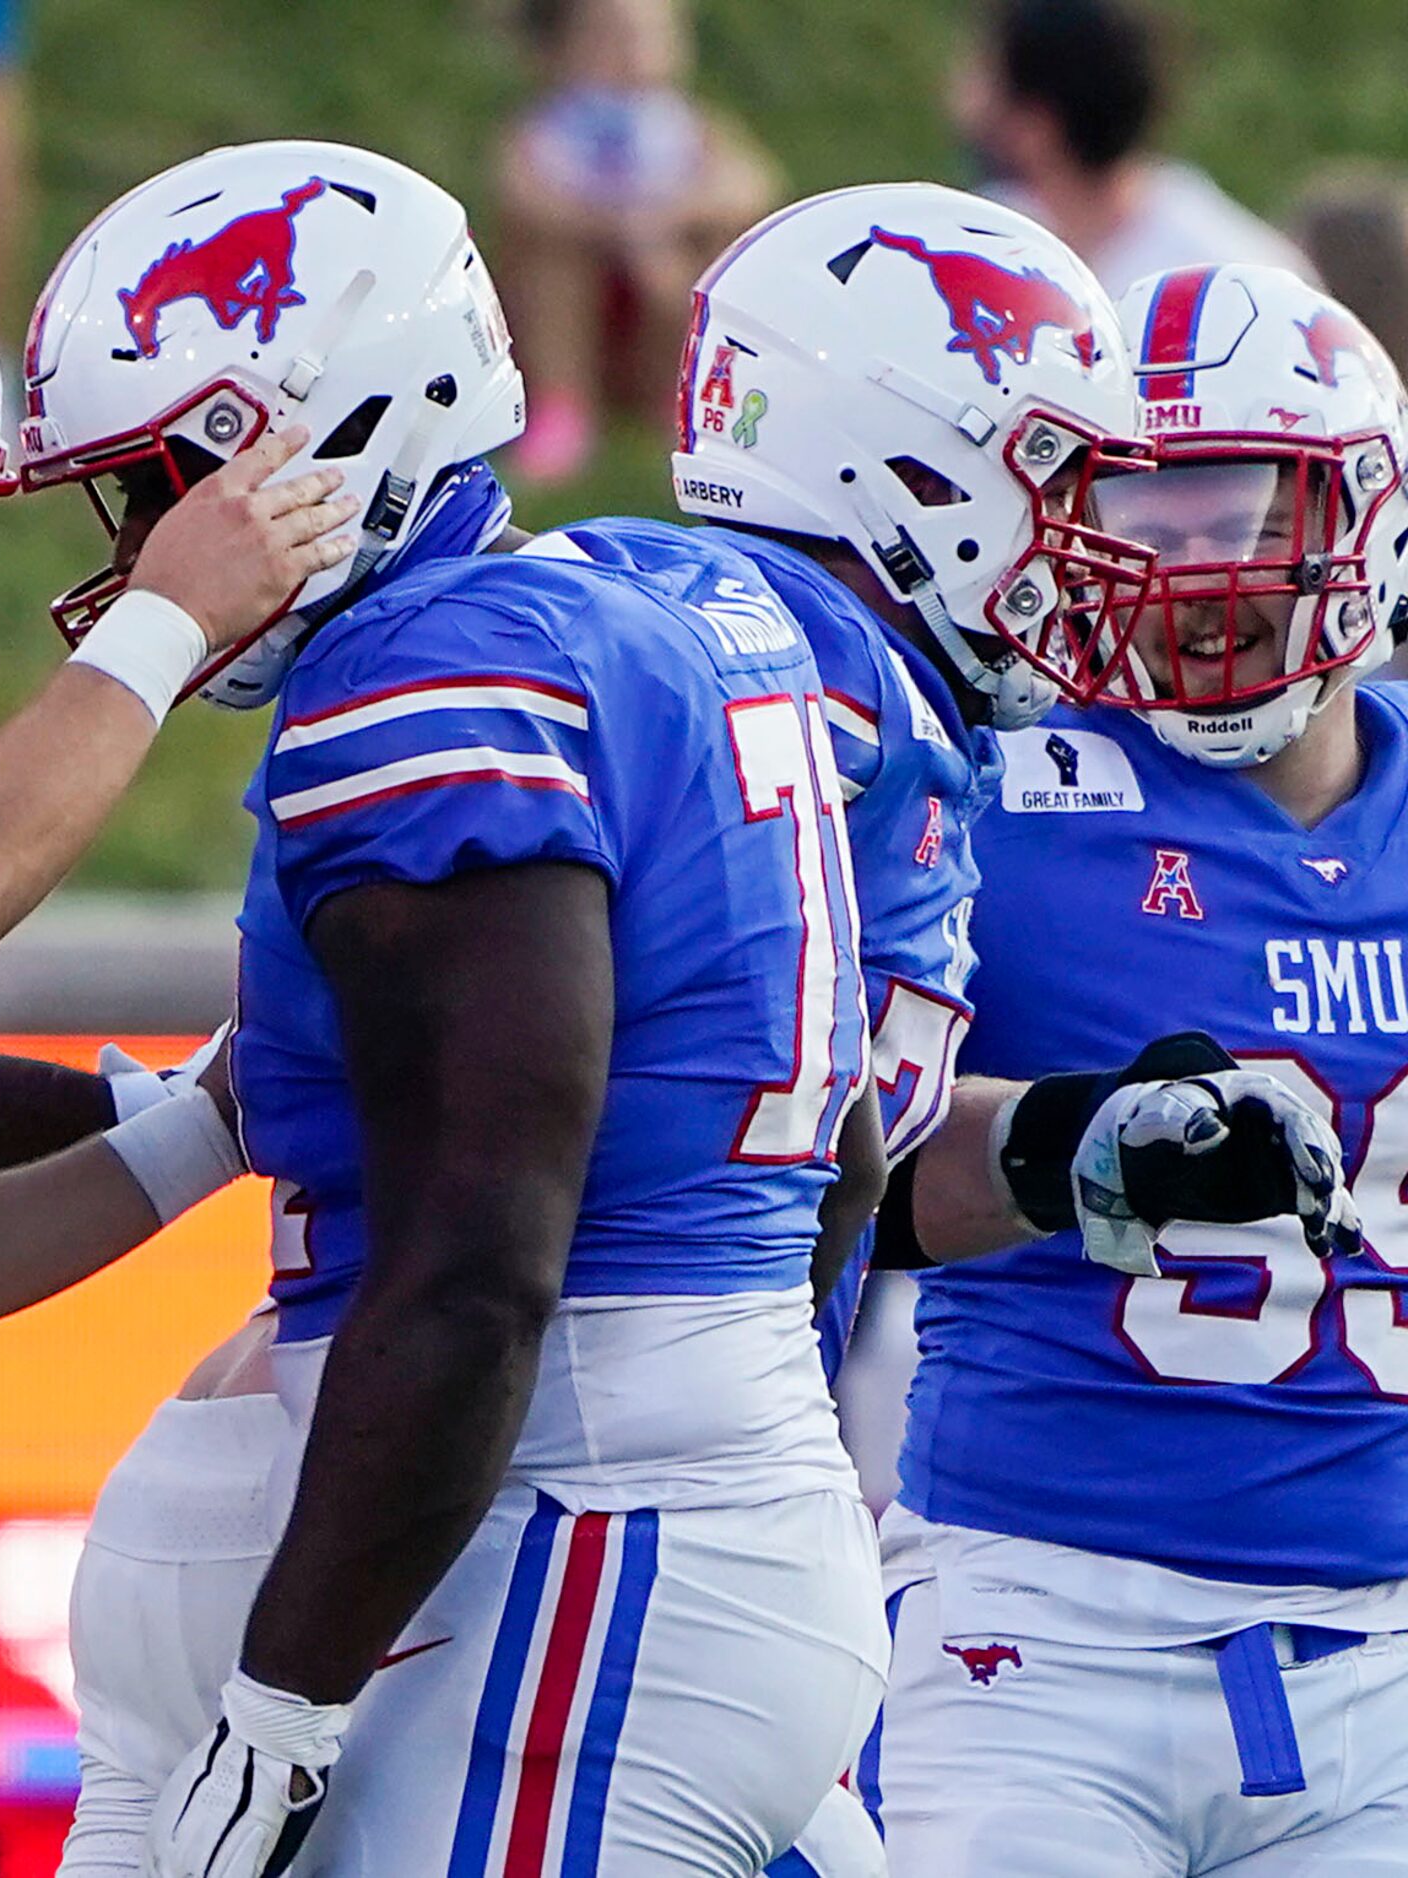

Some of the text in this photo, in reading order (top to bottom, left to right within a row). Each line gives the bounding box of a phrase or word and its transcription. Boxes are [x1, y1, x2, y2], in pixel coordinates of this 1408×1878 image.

[703, 408, 724, 432] P6
[1187, 718, 1253, 734] Riddell
[1022, 791, 1124, 809] GREAT FAMILY
[1265, 939, 1408, 1033] SMU
